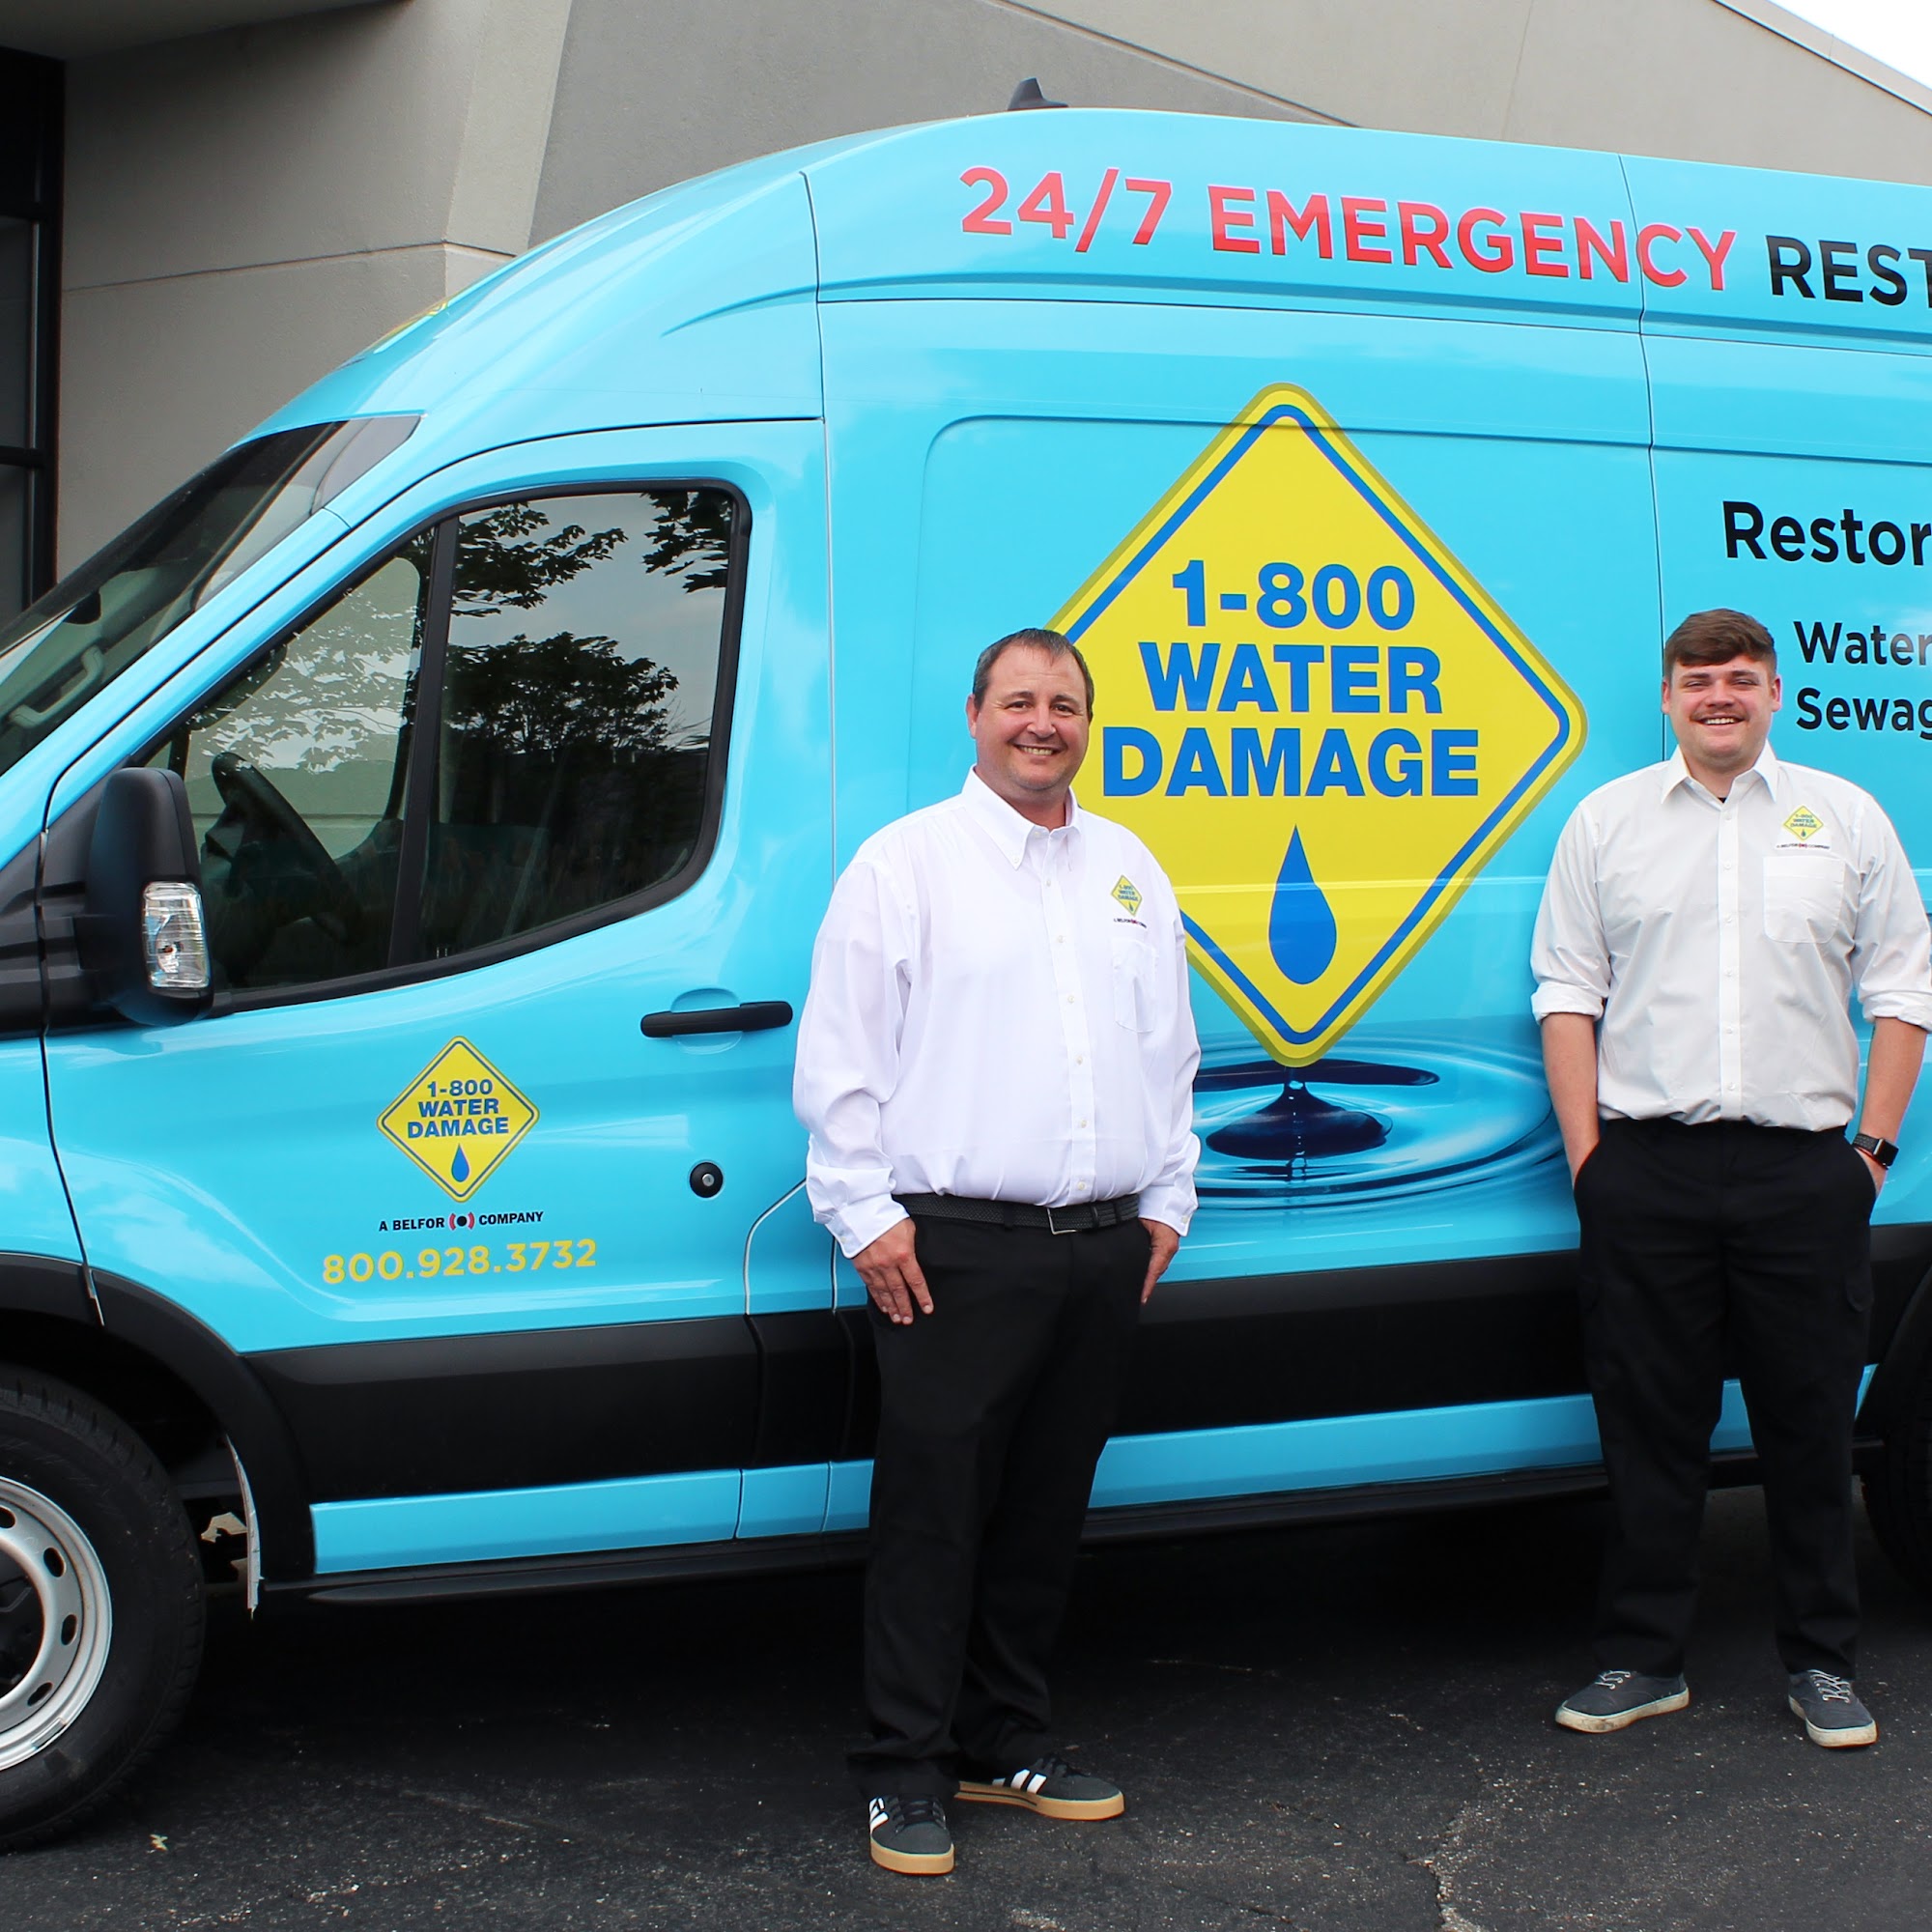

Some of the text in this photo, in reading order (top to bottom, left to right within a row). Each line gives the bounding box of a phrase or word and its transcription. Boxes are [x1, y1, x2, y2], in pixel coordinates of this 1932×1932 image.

[959, 166, 1173, 252] 24/7
[1208, 185, 1736, 291] EMERGENCY
[1722, 500, 1932, 566] Restor
[1172, 559, 1415, 631] 1-800
[1793, 621, 1932, 666] Water
[1138, 641, 1442, 714] WATER
[1102, 726, 1479, 798] DAMAGE
[418, 1097, 499, 1118] WATER
[427, 1078, 494, 1097] 1-800
[408, 1117, 509, 1139] DAMAGE
[379, 1210, 545, 1232] A BELFOR COMPANY
[322, 1237, 597, 1285] 800.928.3732
